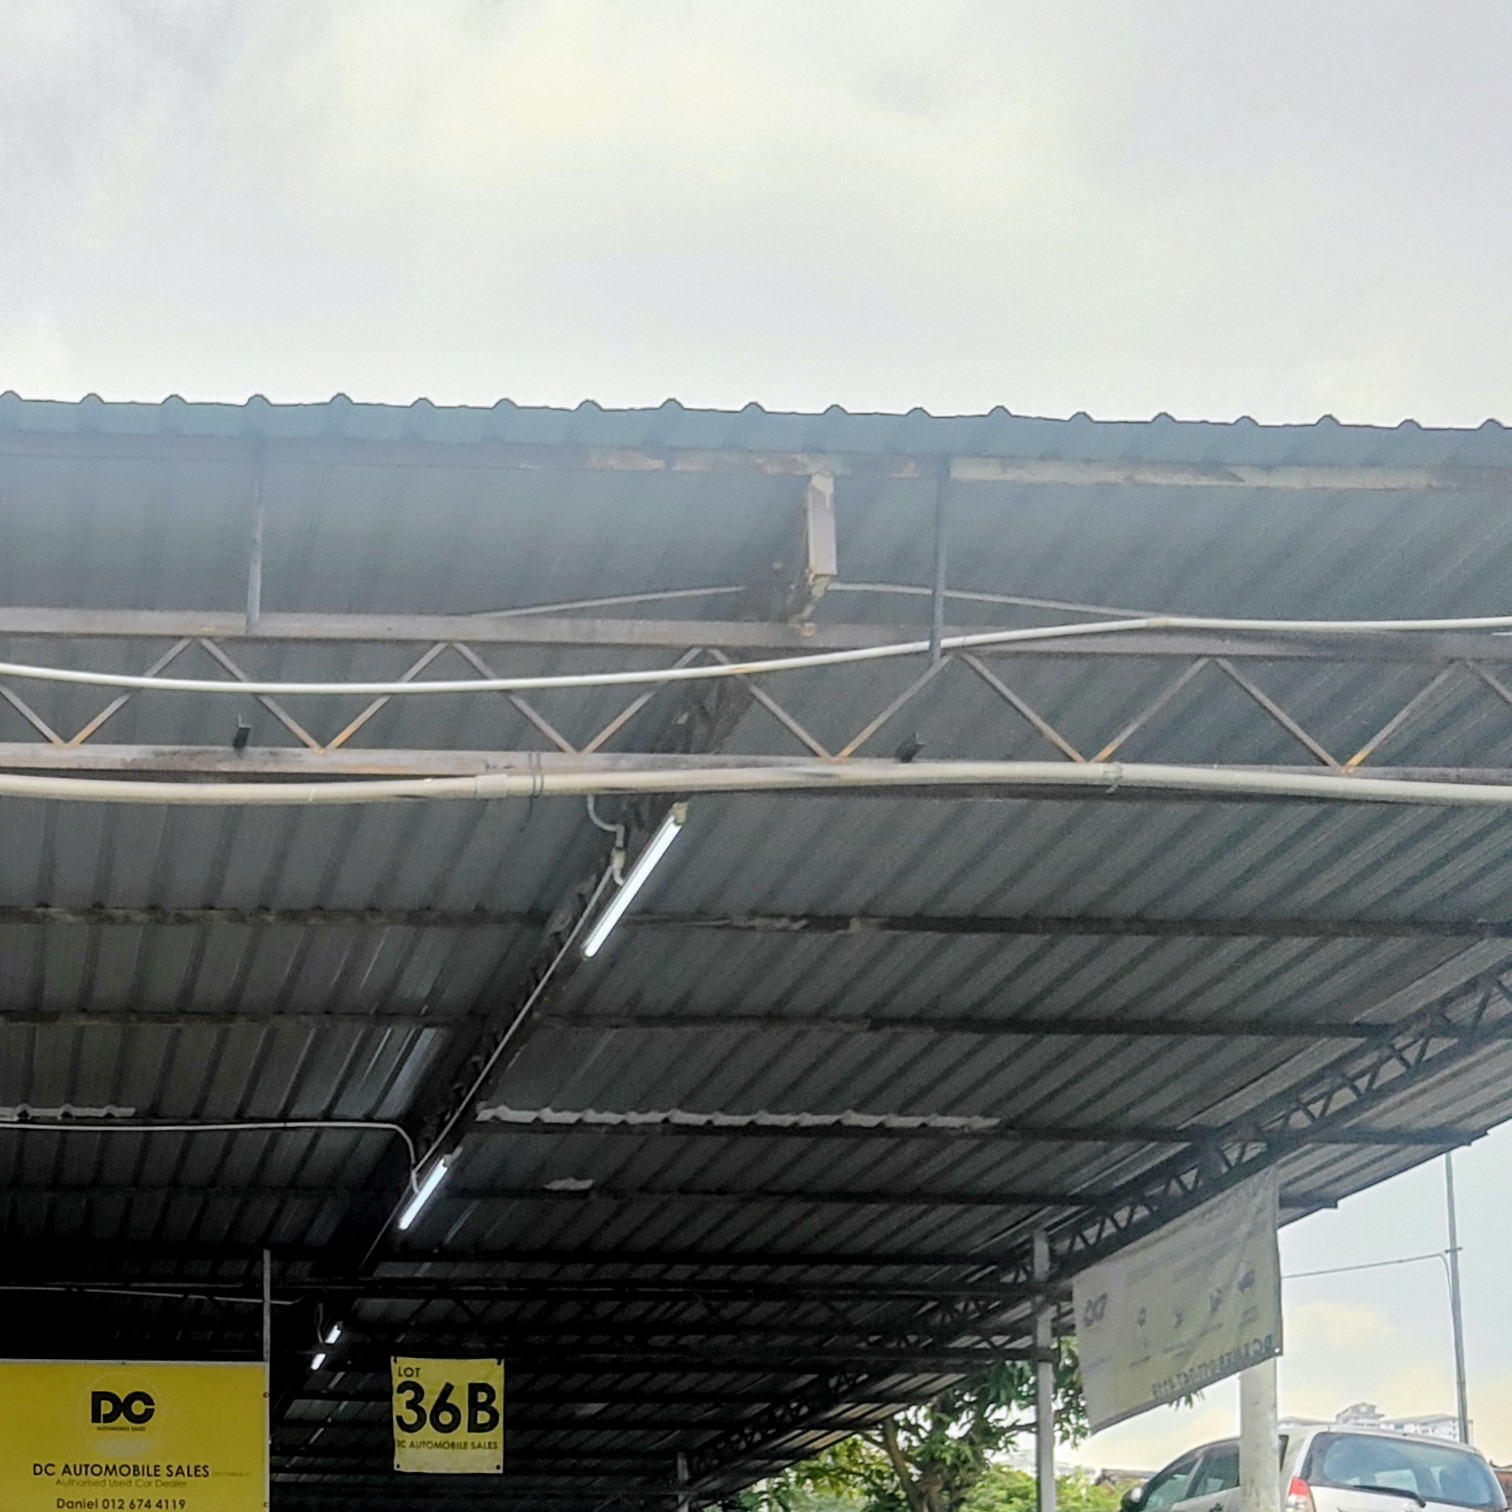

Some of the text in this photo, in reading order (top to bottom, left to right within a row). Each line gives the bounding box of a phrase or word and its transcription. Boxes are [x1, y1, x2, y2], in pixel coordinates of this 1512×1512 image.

[397, 1366, 421, 1378] LOT
[91, 1391, 155, 1425] DC
[395, 1380, 500, 1434] 36B
[409, 1441, 468, 1450] AUTOMOBILE
[471, 1441, 498, 1450] SALES
[33, 1463, 56, 1476] DC
[61, 1463, 161, 1477] AUTOMOBILE
[166, 1464, 210, 1478] SALES
[109, 1479, 133, 1488] Used
[135, 1480, 153, 1488] Car
[155, 1480, 187, 1488] Dealer
[56, 1498, 186, 1510] Daniel 012 674 4119
